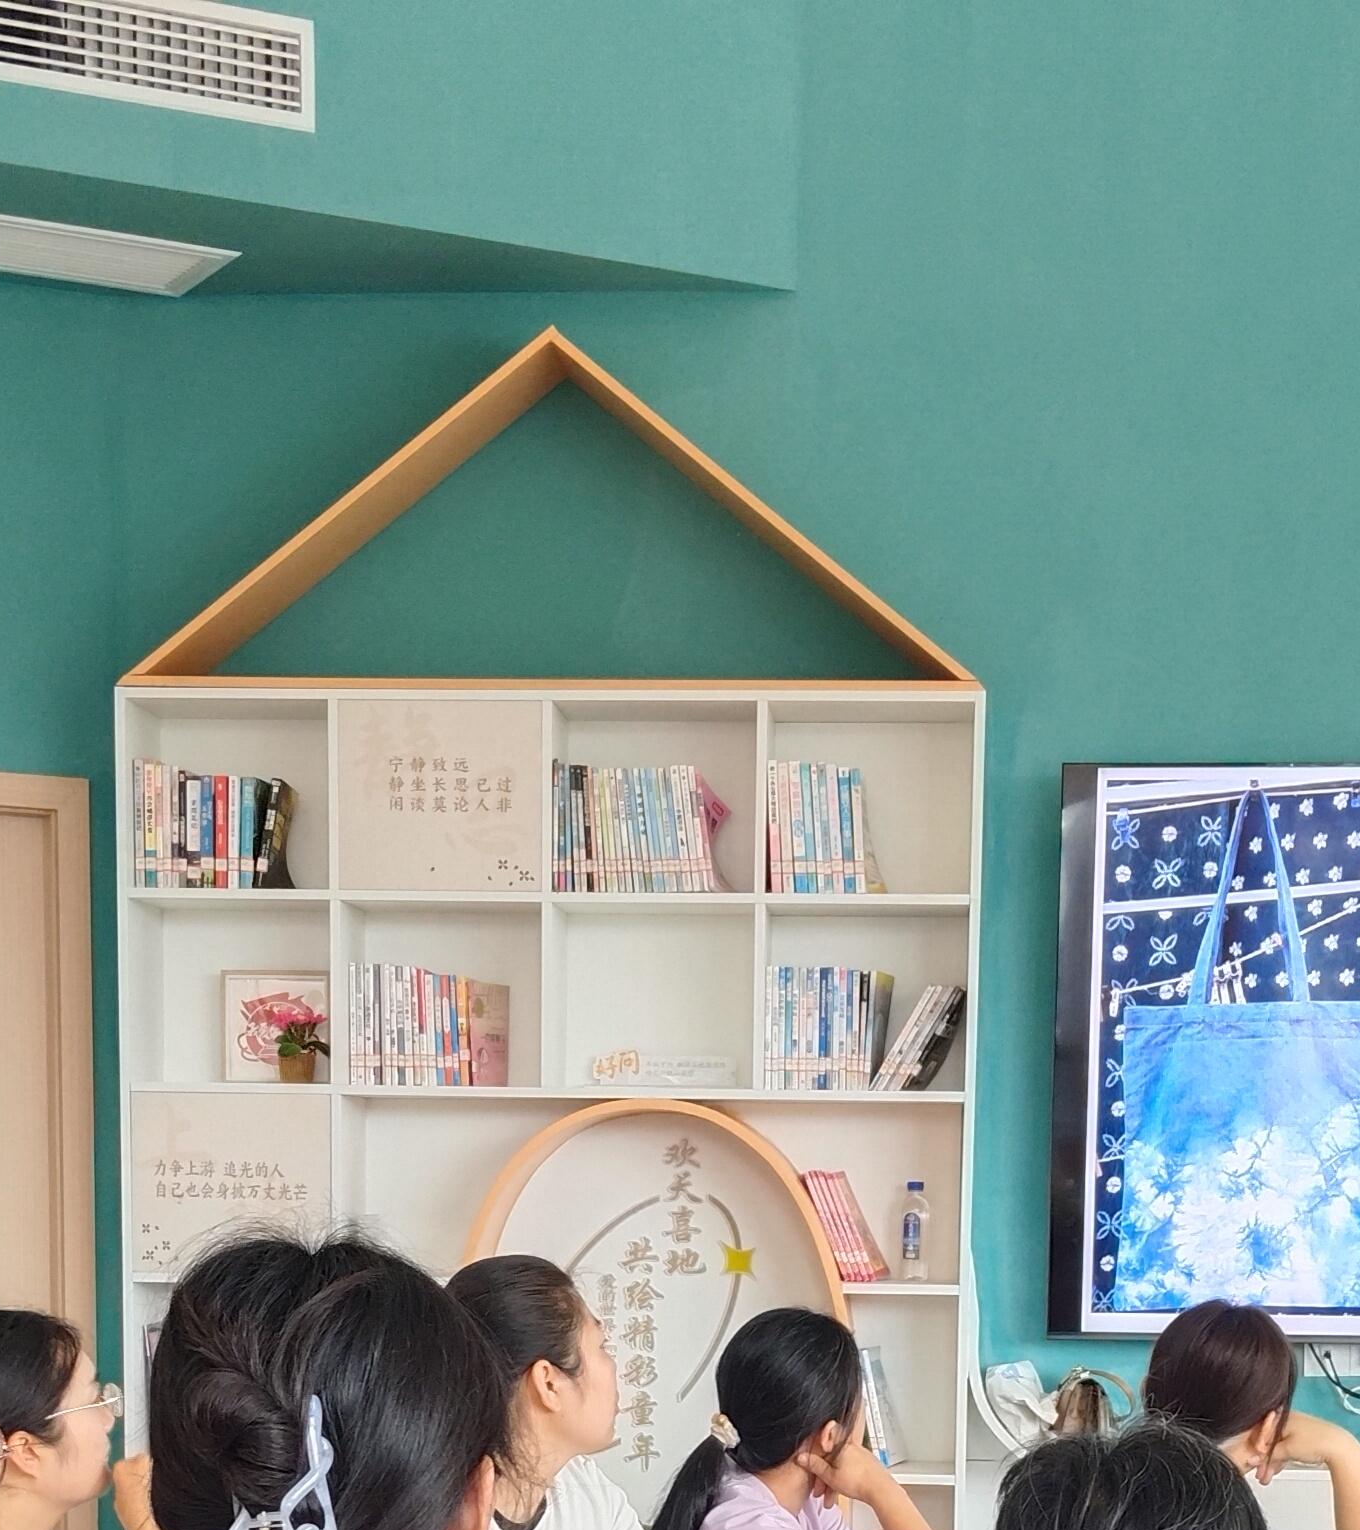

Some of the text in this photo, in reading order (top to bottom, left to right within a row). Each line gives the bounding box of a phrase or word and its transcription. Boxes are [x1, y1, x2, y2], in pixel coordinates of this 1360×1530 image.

[389, 756, 471, 773] 宁静致远
[389, 777, 512, 792] 静坐长思己过
[389, 796, 512, 813] 闲谈莫论人非
[154, 1160, 285, 1178] 力争上游 追光的人
[156, 1181, 308, 1200] 自己也会身披万丈光芒
[618, 1238, 664, 1472] 共绘精彩童年
